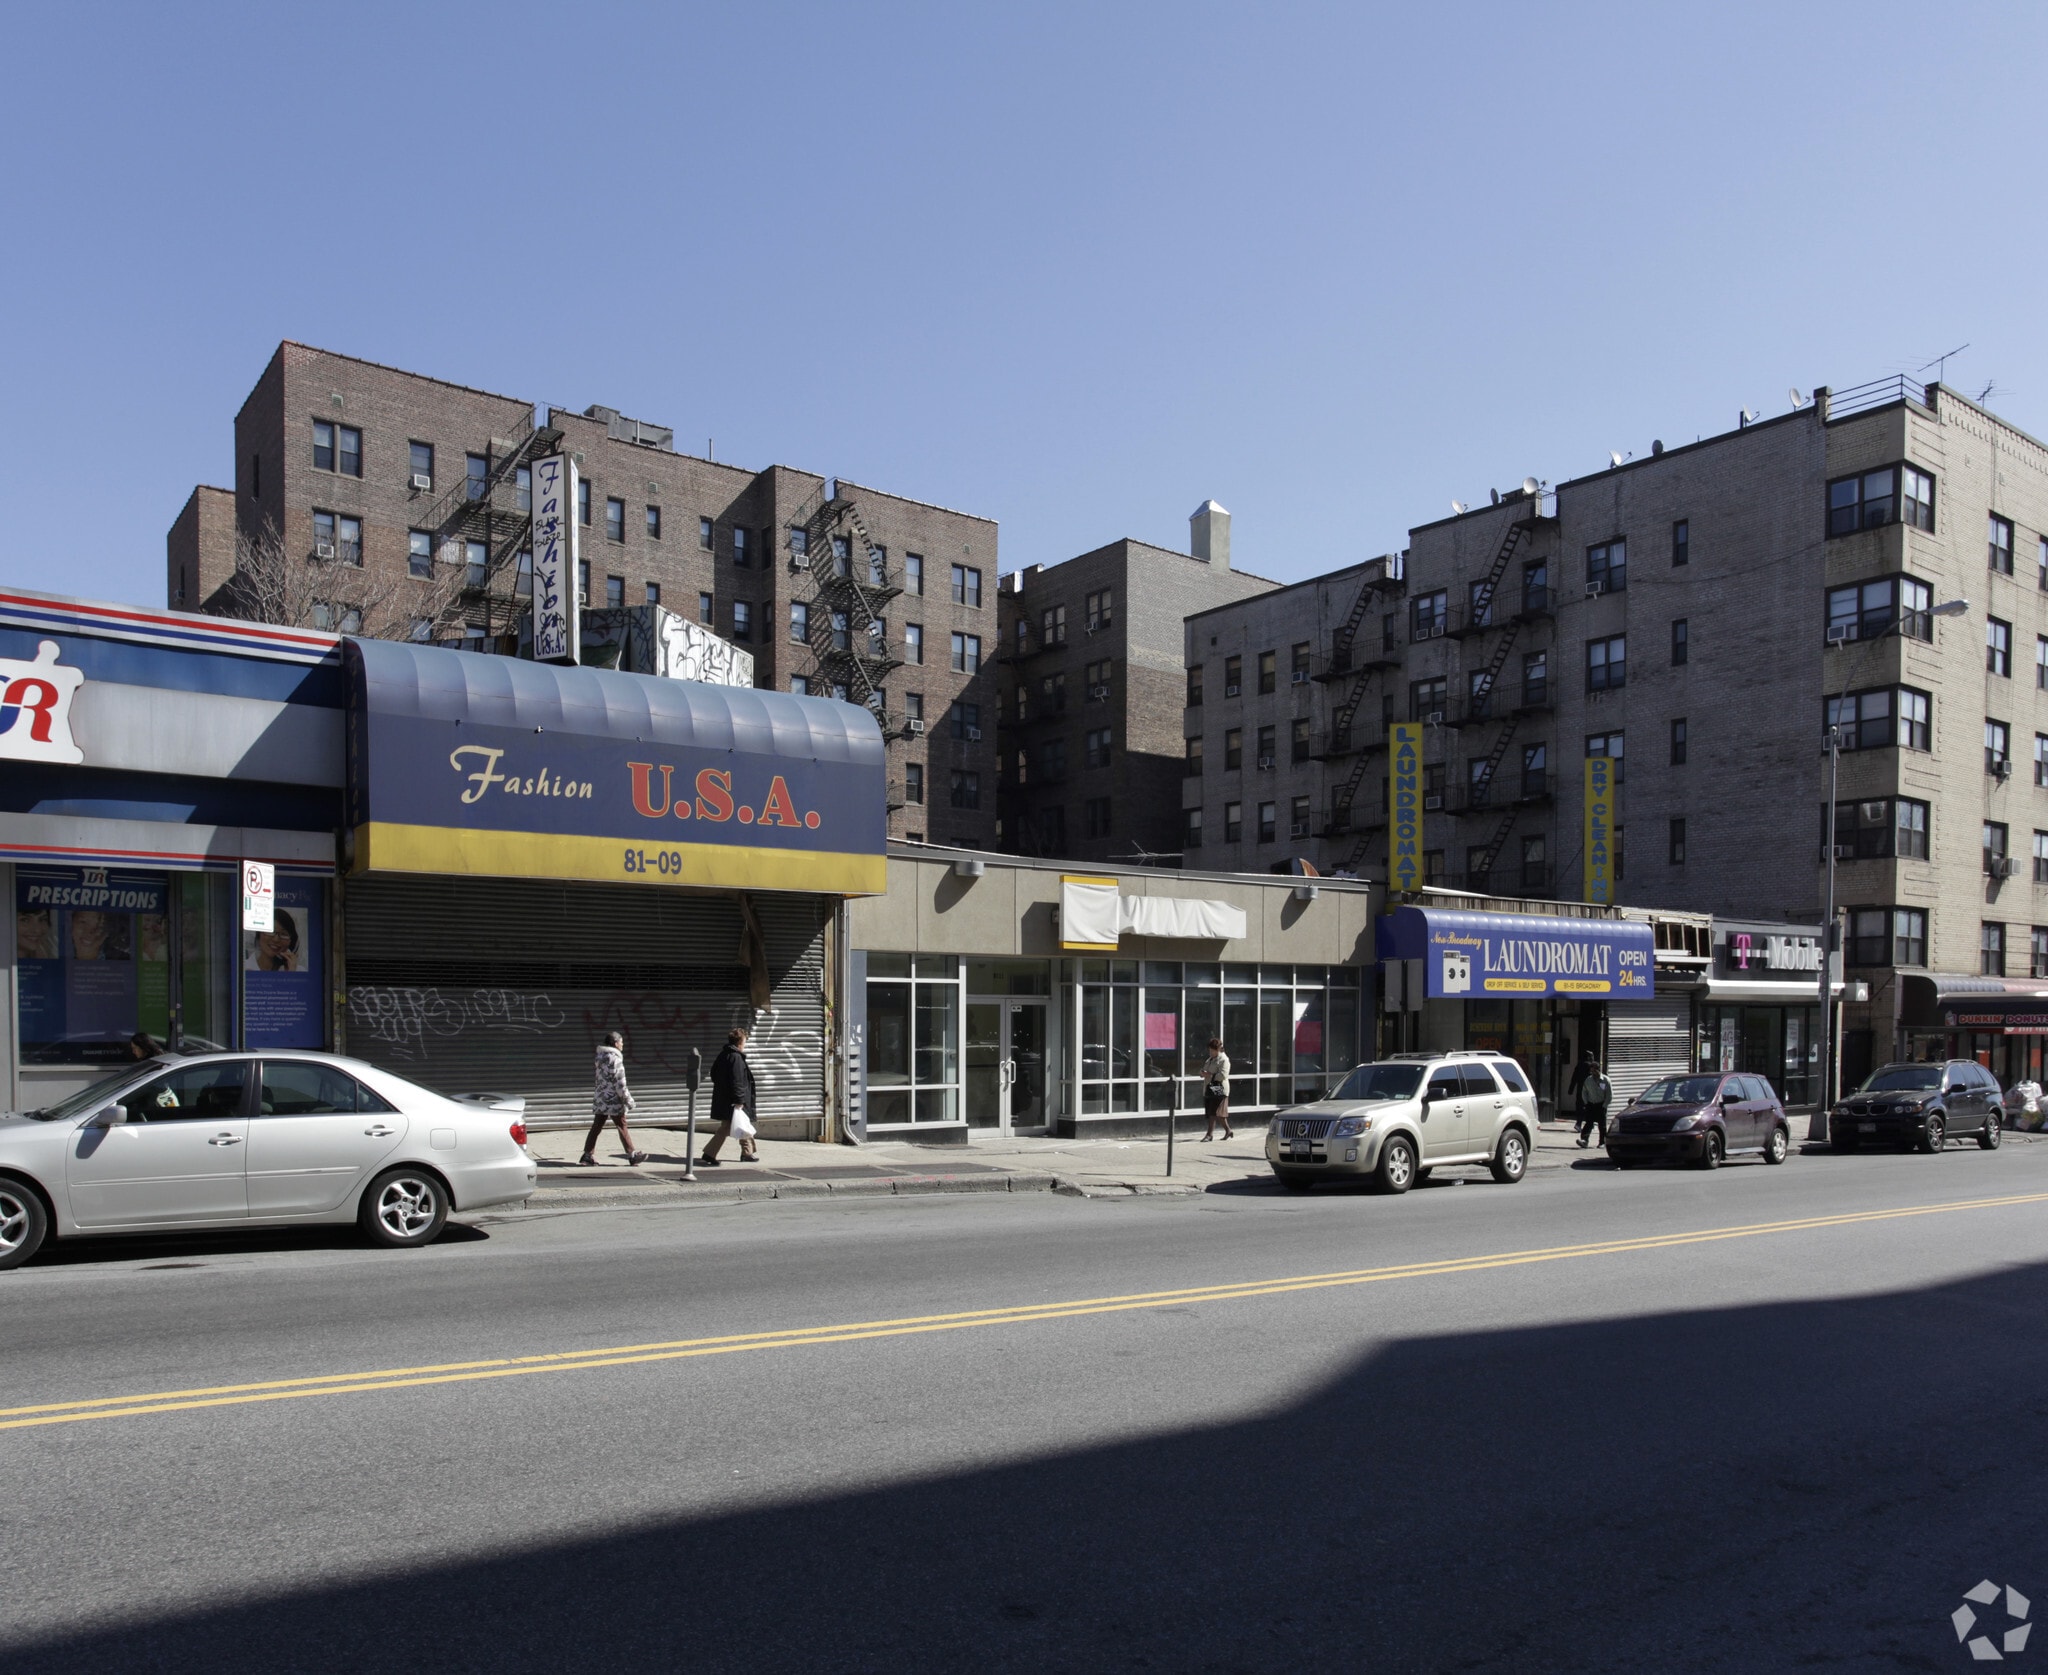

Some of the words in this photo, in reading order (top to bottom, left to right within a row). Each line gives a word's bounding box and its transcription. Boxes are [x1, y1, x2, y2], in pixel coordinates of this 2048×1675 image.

[450, 745, 593, 804] Fashion
[627, 761, 821, 829] U.S.A.
[1592, 760, 1608, 798] DRY
[1396, 727, 1416, 889] LAUNDROMAT
[623, 848, 682, 875] 81-09
[1592, 803, 1608, 903] CLEANING
[27, 885, 158, 909] PRESCRIPTIONS
[1483, 938, 1611, 975] LAUNDROMAT
[1618, 950, 1647, 966] OPEN
[1618, 970, 1633, 986] 24
